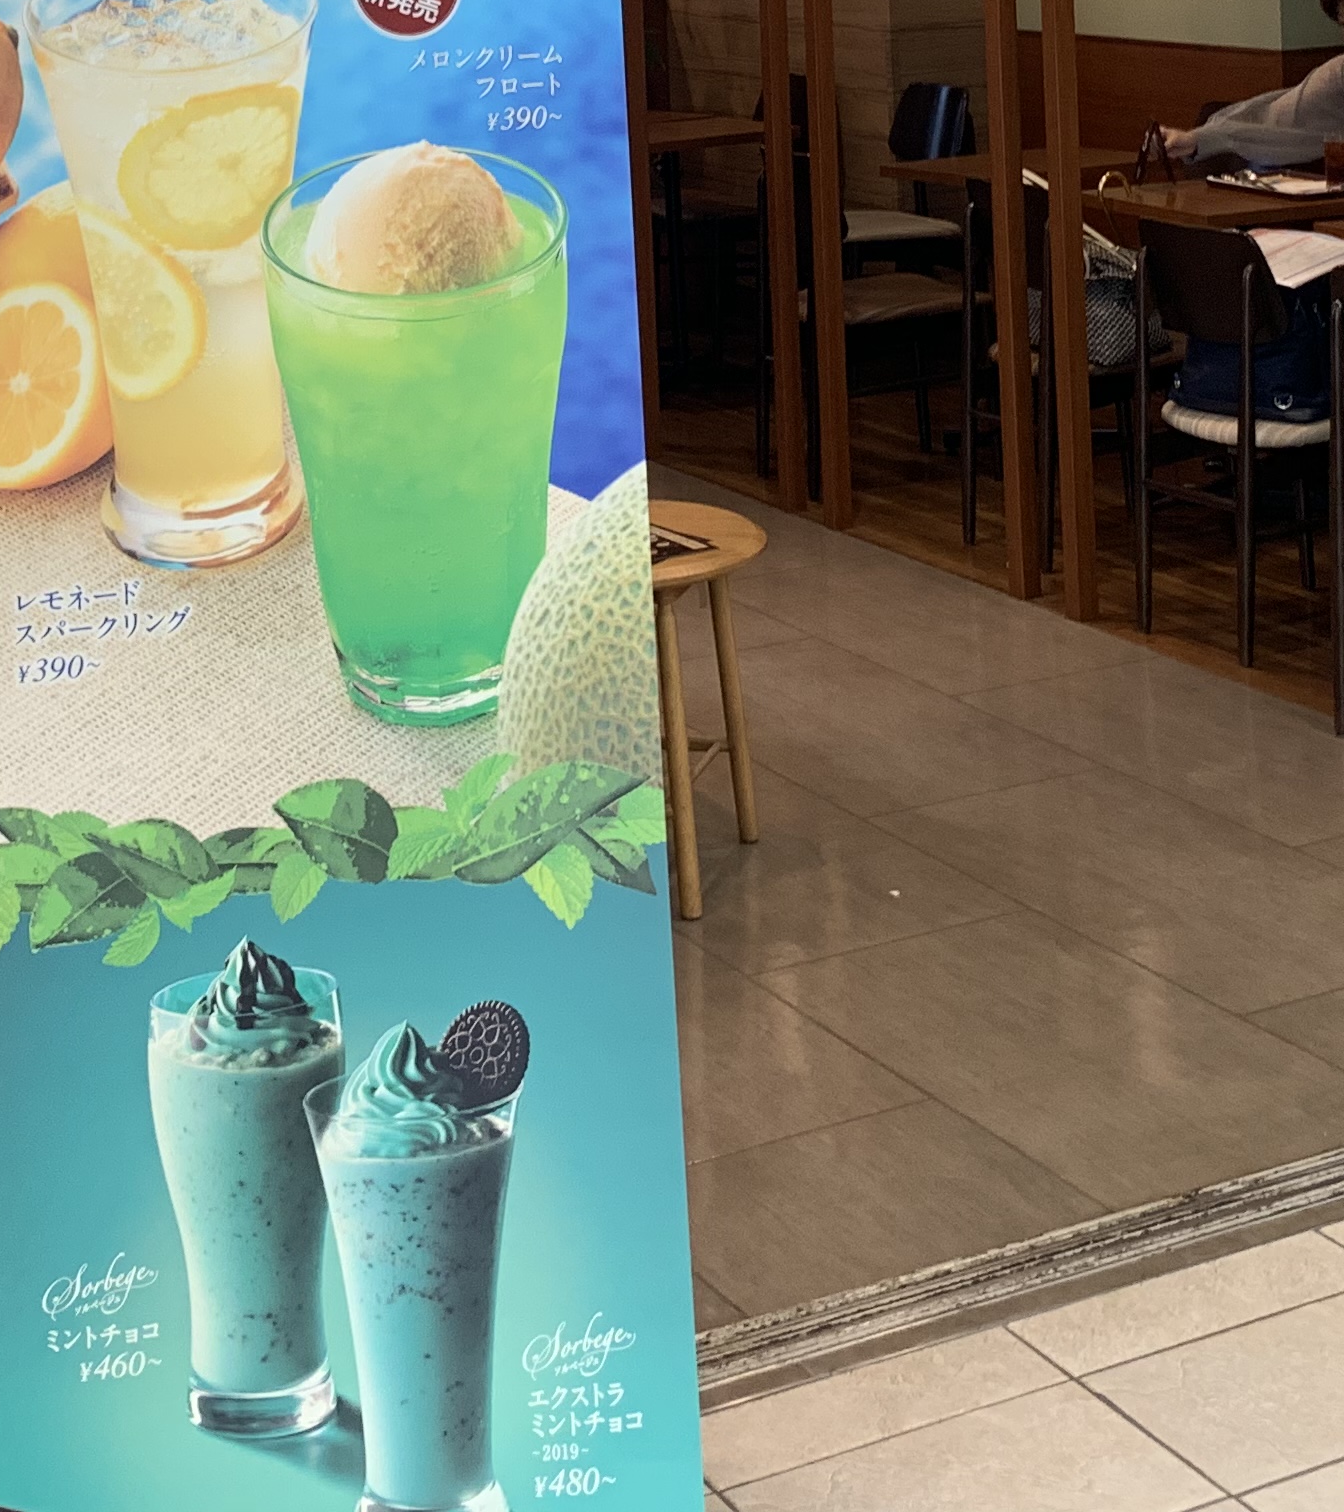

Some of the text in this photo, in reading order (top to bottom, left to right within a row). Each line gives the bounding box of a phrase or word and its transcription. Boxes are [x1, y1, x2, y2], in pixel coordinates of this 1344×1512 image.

[409, 45, 563, 73] メロンクリーム
[476, 72, 562, 99] フロート
[16, 580, 140, 611] レモネード
[16, 606, 191, 646] スパークリング
[47, 1322, 159, 1352] ミントチョコ
[527, 1381, 625, 1410] エクストラ
[531, 1410, 644, 1438] ミントチョコ
